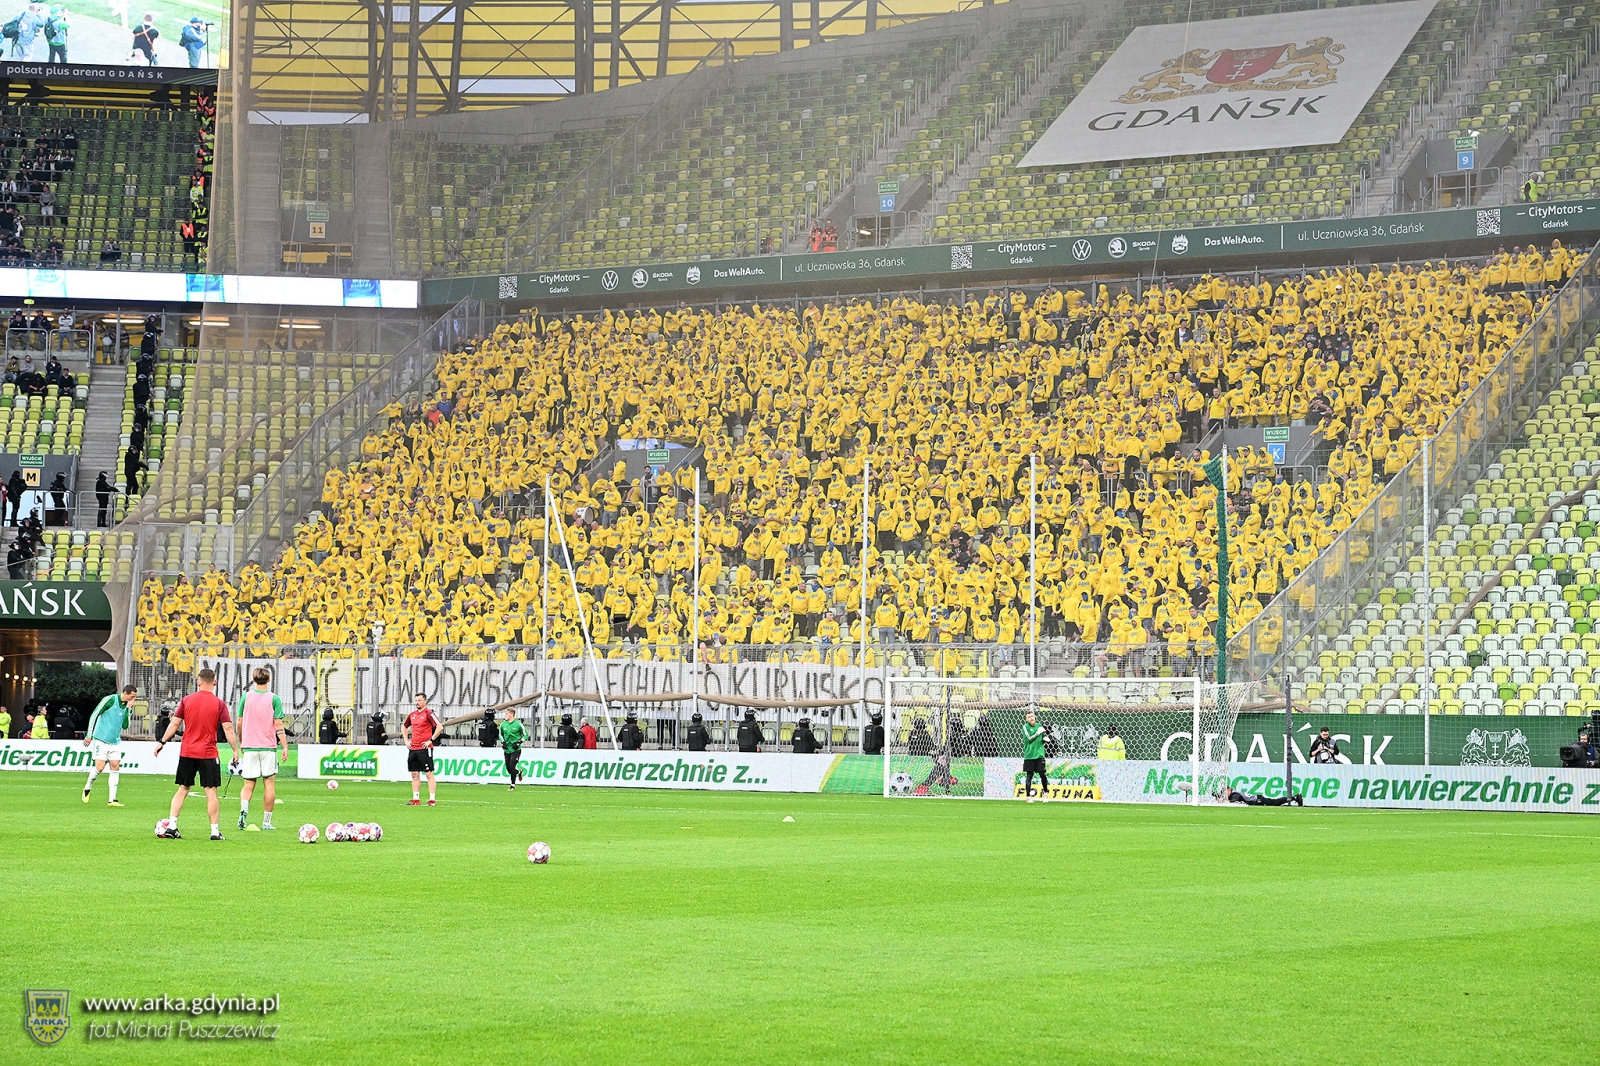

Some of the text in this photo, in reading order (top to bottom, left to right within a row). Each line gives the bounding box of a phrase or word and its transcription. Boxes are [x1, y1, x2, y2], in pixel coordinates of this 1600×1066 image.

[6, 65, 42, 76] polsat
[46, 67, 70, 77] plus
[72, 69, 106, 77] arena
[1087, 95, 1327, 131] GDAŃSK
[1462, 156, 1469, 165] 9
[882, 199, 893, 207] 10
[1528, 204, 1583, 217] CityMotors
[1542, 219, 1569, 228] Gdańsk
[312, 226, 323, 234] 11
[1298, 223, 1425, 241] ul. Uczniowska 36, Gdańsk
[1204, 235, 1264, 247] Das WeltAuto.
[998, 242, 1046, 255] CityMotors
[795, 256, 906, 273] ul. Uczniowska 36, Gdańsk
[1010, 256, 1033, 264] Gdańsk
[714, 267, 765, 278] Das WeltAuto.
[539, 273, 580, 284] CityMotors
[549, 286, 570, 294] Gdańsk
[1273, 448, 1280, 459] K
[26, 472, 36, 482] M
[545, 667, 582, 710] ALE
[323, 760, 376, 770] trawnik
[422, 757, 768, 785] owoczsne nawierzchnie z...
[1348, 774, 1575, 805] nawierzchnie
